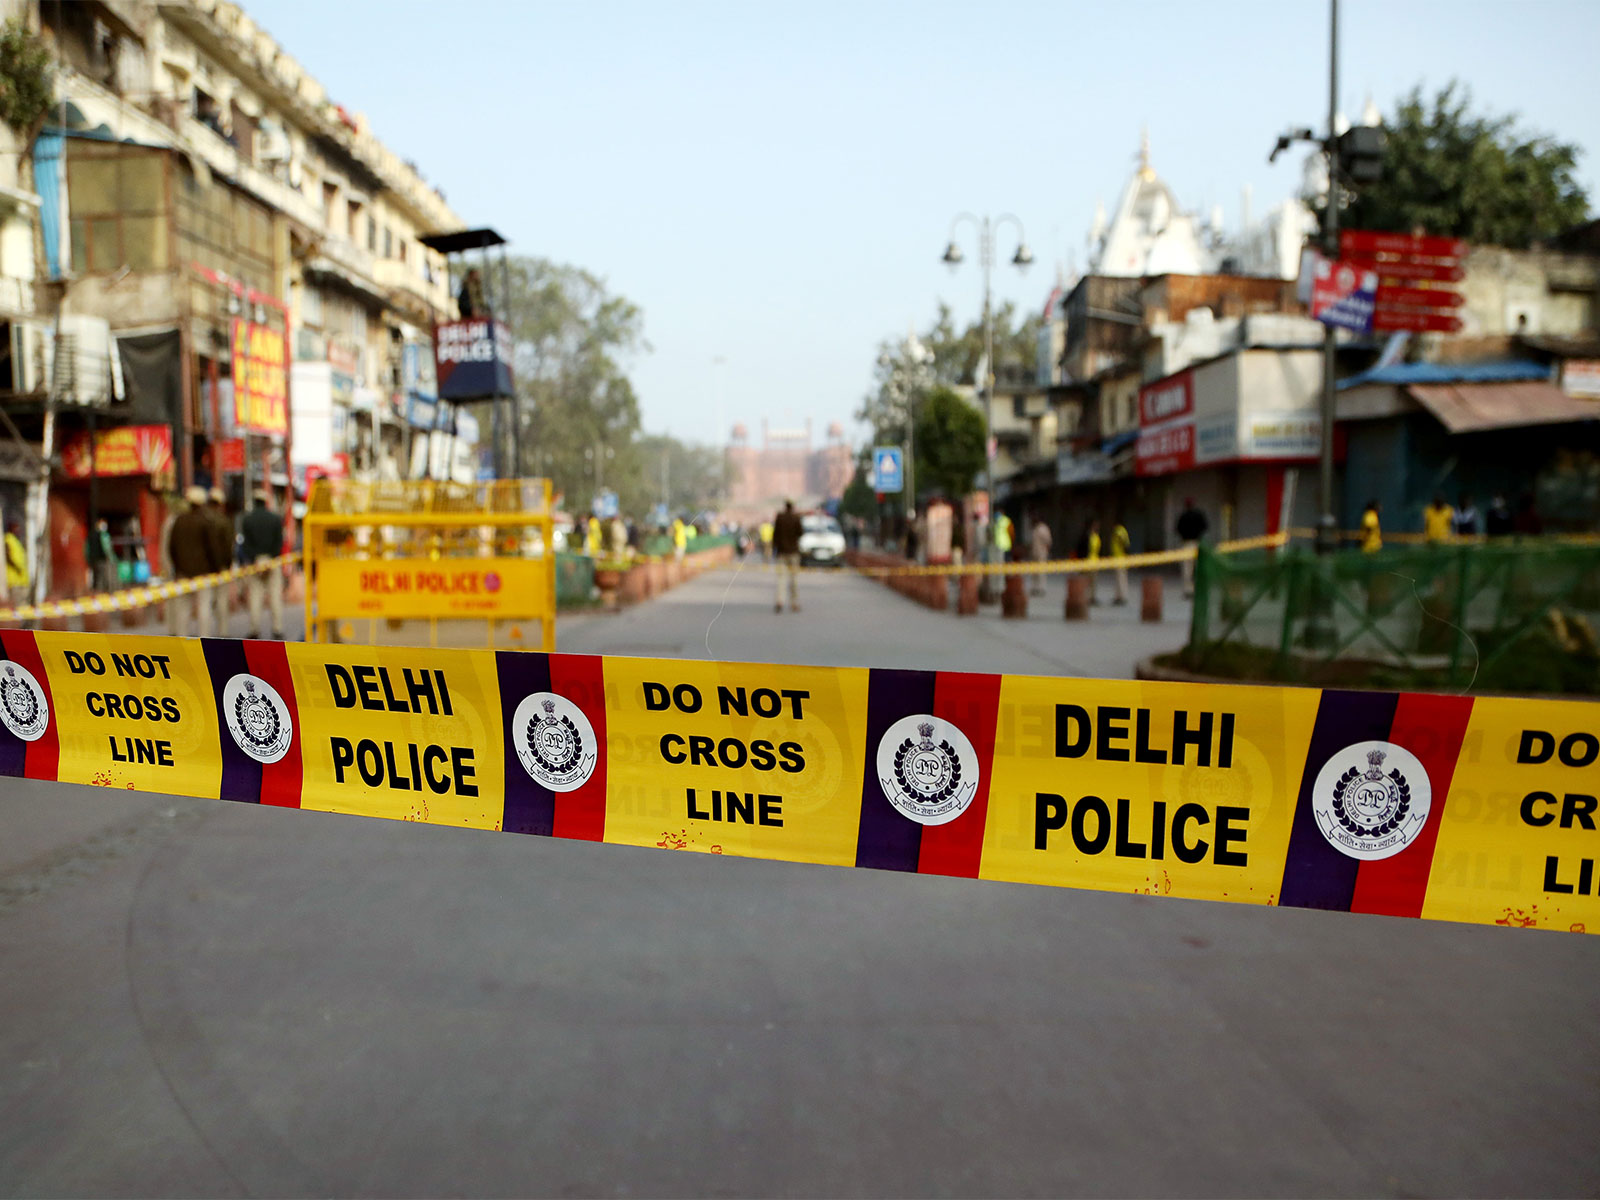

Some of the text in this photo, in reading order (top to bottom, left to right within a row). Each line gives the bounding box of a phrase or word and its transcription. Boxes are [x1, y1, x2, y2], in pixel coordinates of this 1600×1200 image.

[437, 340, 494, 364] POLICE
[361, 571, 480, 594] DELHI POLICE
[63, 650, 171, 681] DO NOT
[85, 691, 181, 723] CROSS
[324, 663, 454, 716] DELHI
[642, 681, 810, 720] DO NOT
[109, 736, 174, 767] LINE
[659, 733, 806, 773] CROSS
[1055, 703, 1235, 769] DELHI
[1516, 729, 1600, 768] DO
[330, 736, 479, 798] POLICE
[686, 788, 784, 828] LINE
[1034, 792, 1250, 868] POLICE
[1543, 855, 1600, 896] LI
